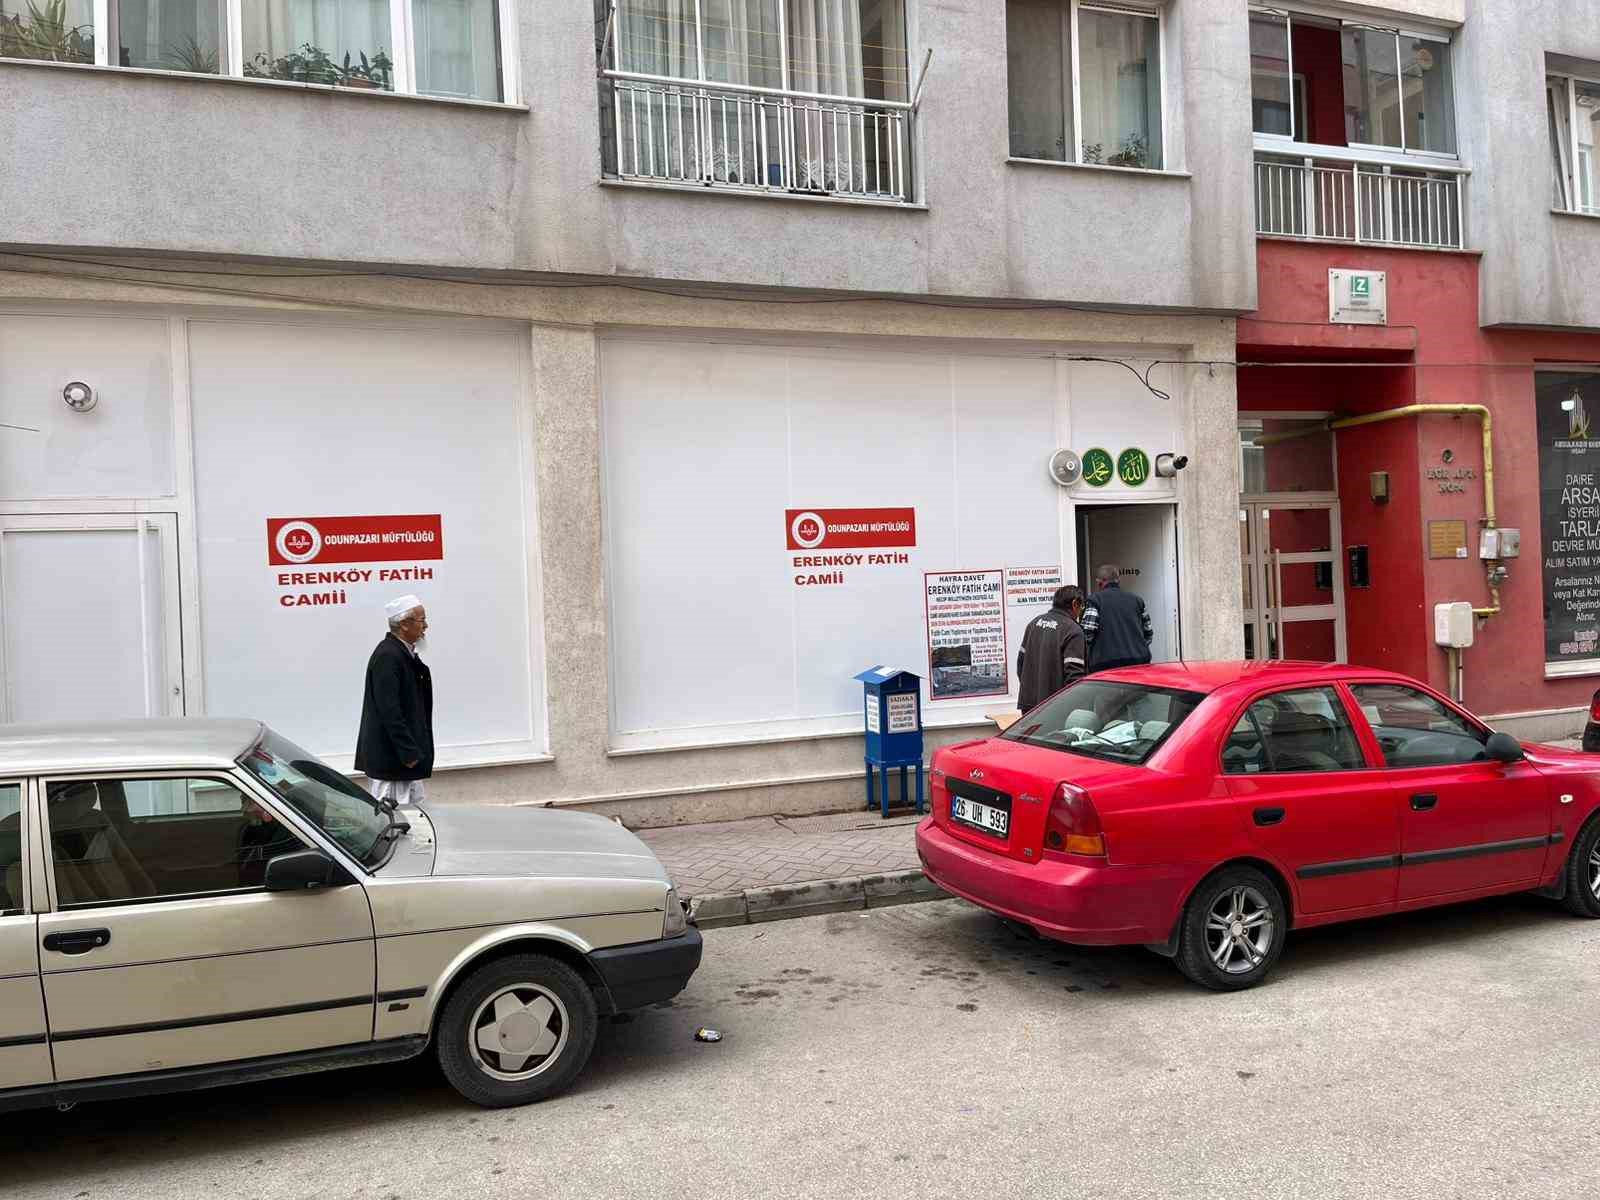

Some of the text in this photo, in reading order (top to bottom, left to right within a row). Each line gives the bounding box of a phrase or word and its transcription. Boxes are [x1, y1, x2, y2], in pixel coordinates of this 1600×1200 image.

[1561, 488, 1600, 504] ARSA
[828, 521, 910, 532] ODUNPAZARI MÜFTÜLÜĞÜ
[324, 530, 434, 544] ODUNPAZARI MÜFTÜLÜĞÜ
[1552, 540, 1584, 552] DEVRE
[793, 552, 908, 567] ERENKÖY FATİH
[1545, 558, 1565, 568] ALIM
[1567, 556, 1590, 567] SATIM
[278, 566, 433, 586] ERENKÖY FATİH
[794, 571, 844, 586] CAMİİ
[928, 584, 960, 595] ERENKÖY
[962, 583, 982, 593] FATİH
[1553, 592, 1570, 600] veya
[1573, 588, 1585, 597] Kat
[280, 590, 346, 607] CAMİİ
[956, 798, 966, 816] 26
[972, 804, 983, 823] UH
[990, 810, 1006, 830] 593
